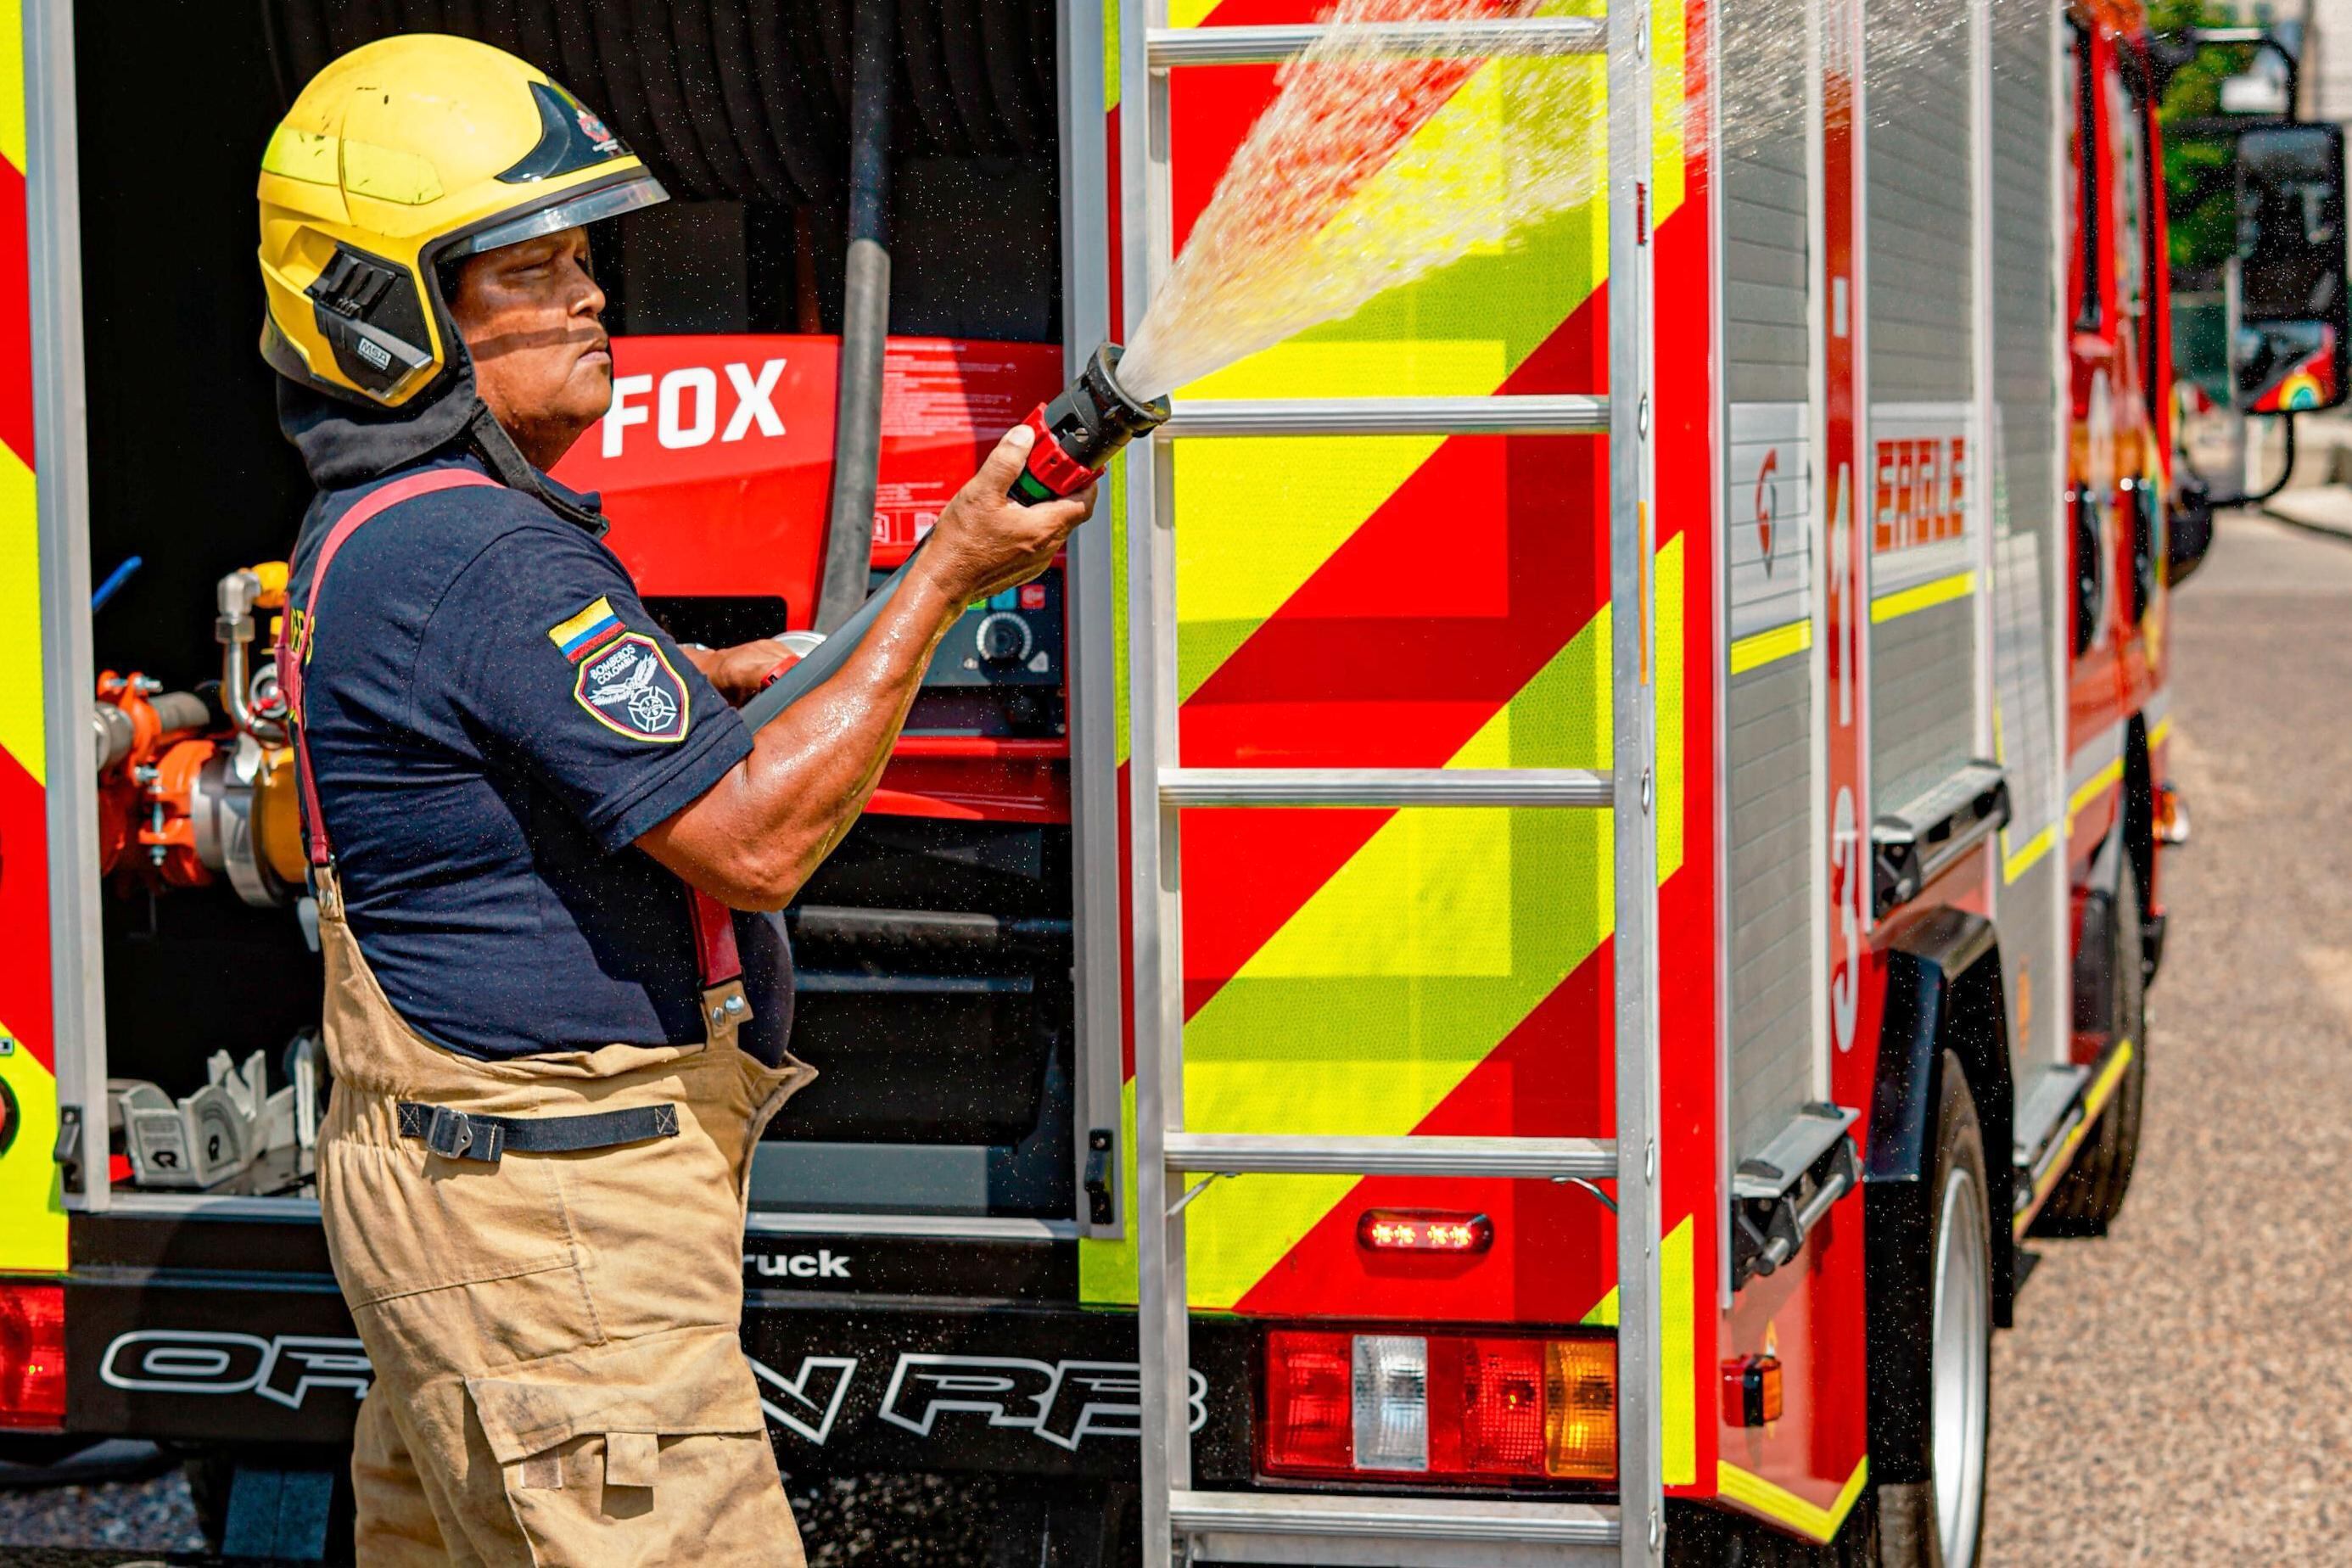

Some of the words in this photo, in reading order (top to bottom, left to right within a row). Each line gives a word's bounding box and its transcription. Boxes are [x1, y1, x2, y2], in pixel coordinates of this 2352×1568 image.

[361, 341, 388, 363] MSA
[602, 358, 787, 458] FOX
[1874, 437, 1965, 553] EAGLE
[590, 644, 636, 680] BOMBEROS
[597, 654, 639, 685] COLOMBIA
